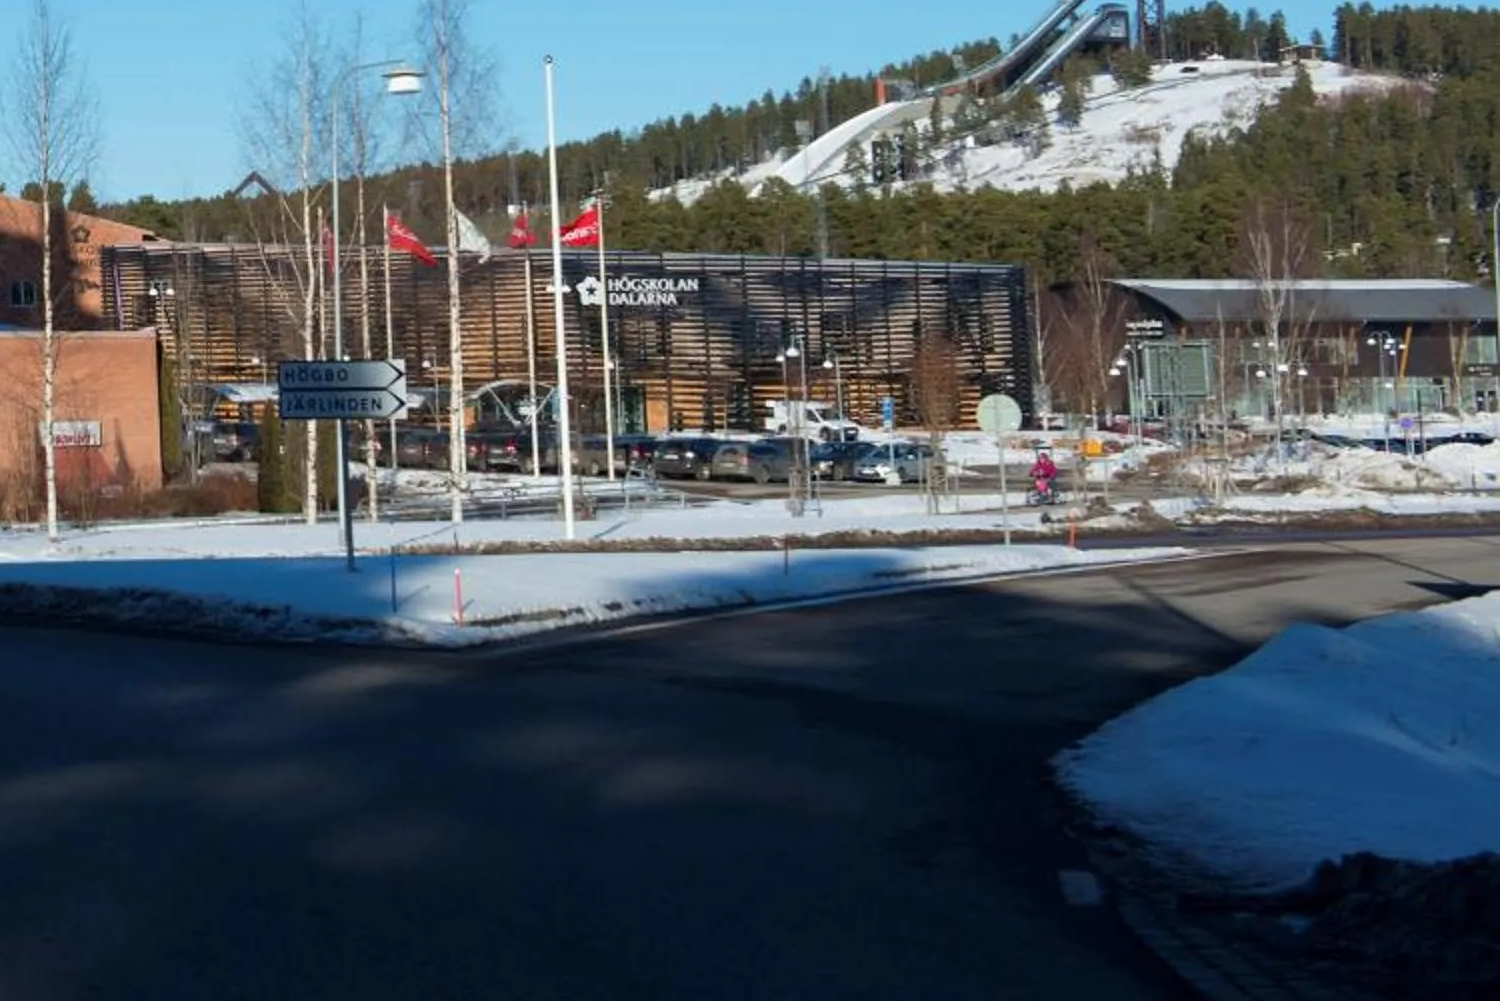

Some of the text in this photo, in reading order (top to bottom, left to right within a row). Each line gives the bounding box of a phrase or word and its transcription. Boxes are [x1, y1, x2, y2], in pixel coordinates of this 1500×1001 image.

[607, 276, 699, 291] HÖGSKOLAN
[609, 292, 677, 306] DALARNA
[284, 364, 348, 382] HÖGBO
